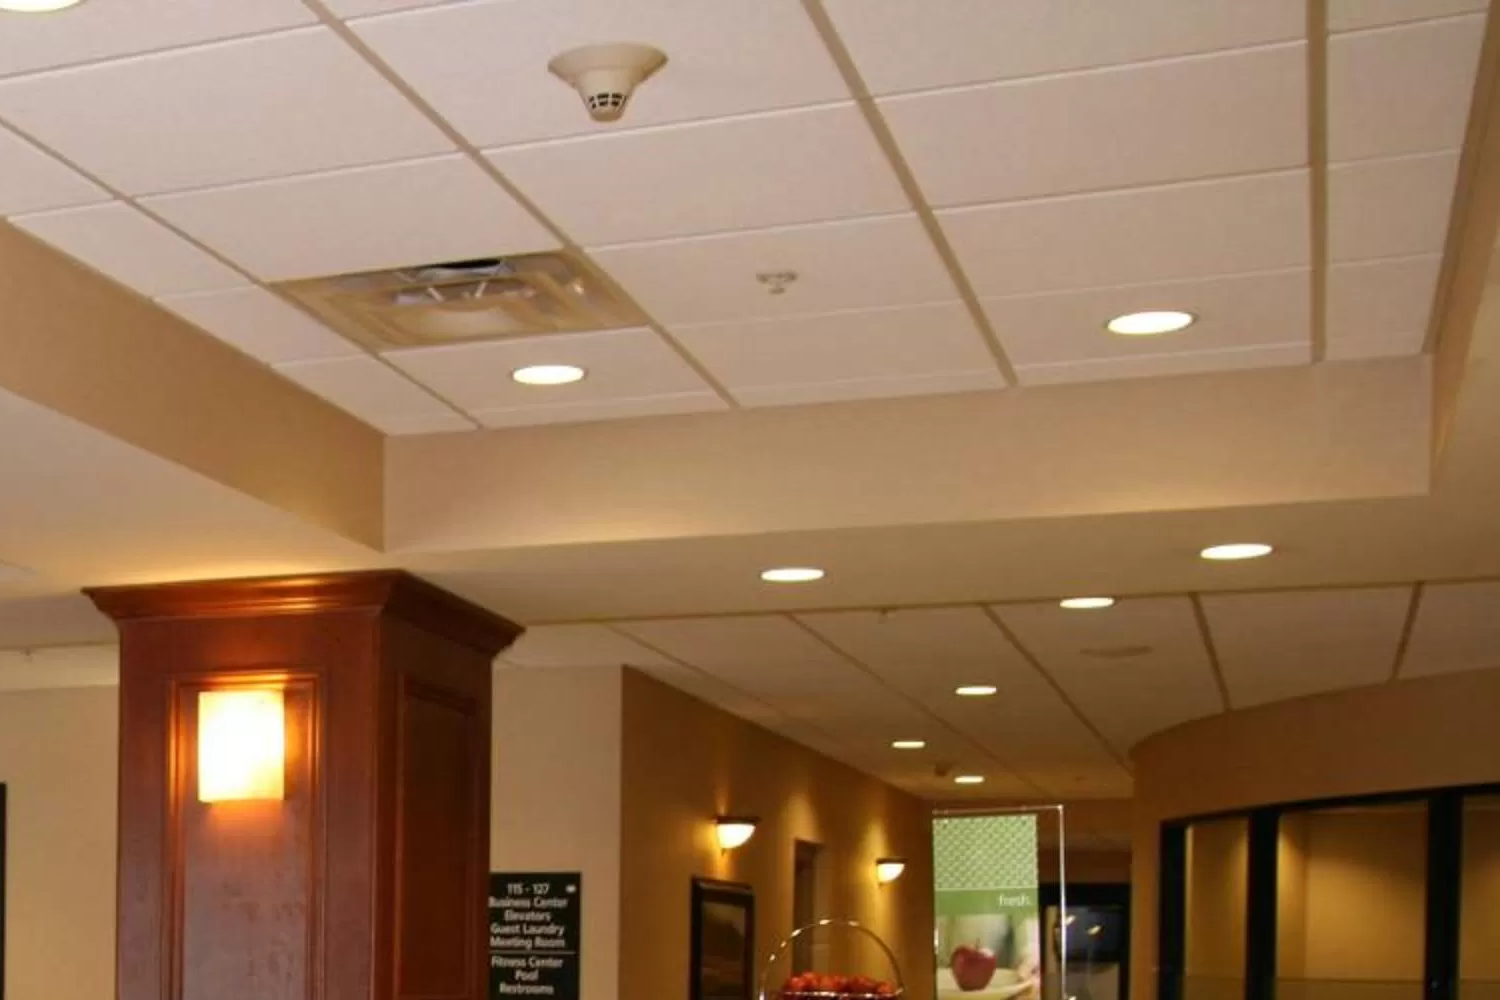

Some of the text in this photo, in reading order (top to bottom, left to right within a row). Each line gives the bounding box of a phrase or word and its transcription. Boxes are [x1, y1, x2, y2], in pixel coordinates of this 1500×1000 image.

[488, 896, 568, 909] Business Center
[504, 909, 551, 922] Elevators
[490, 922, 565, 936] Guest Laundry
[490, 936, 565, 950] Meeting Room
[491, 955, 563, 968] Fitness Center
[515, 969, 539, 980] Pool
[499, 983, 554, 995] Restrooms
